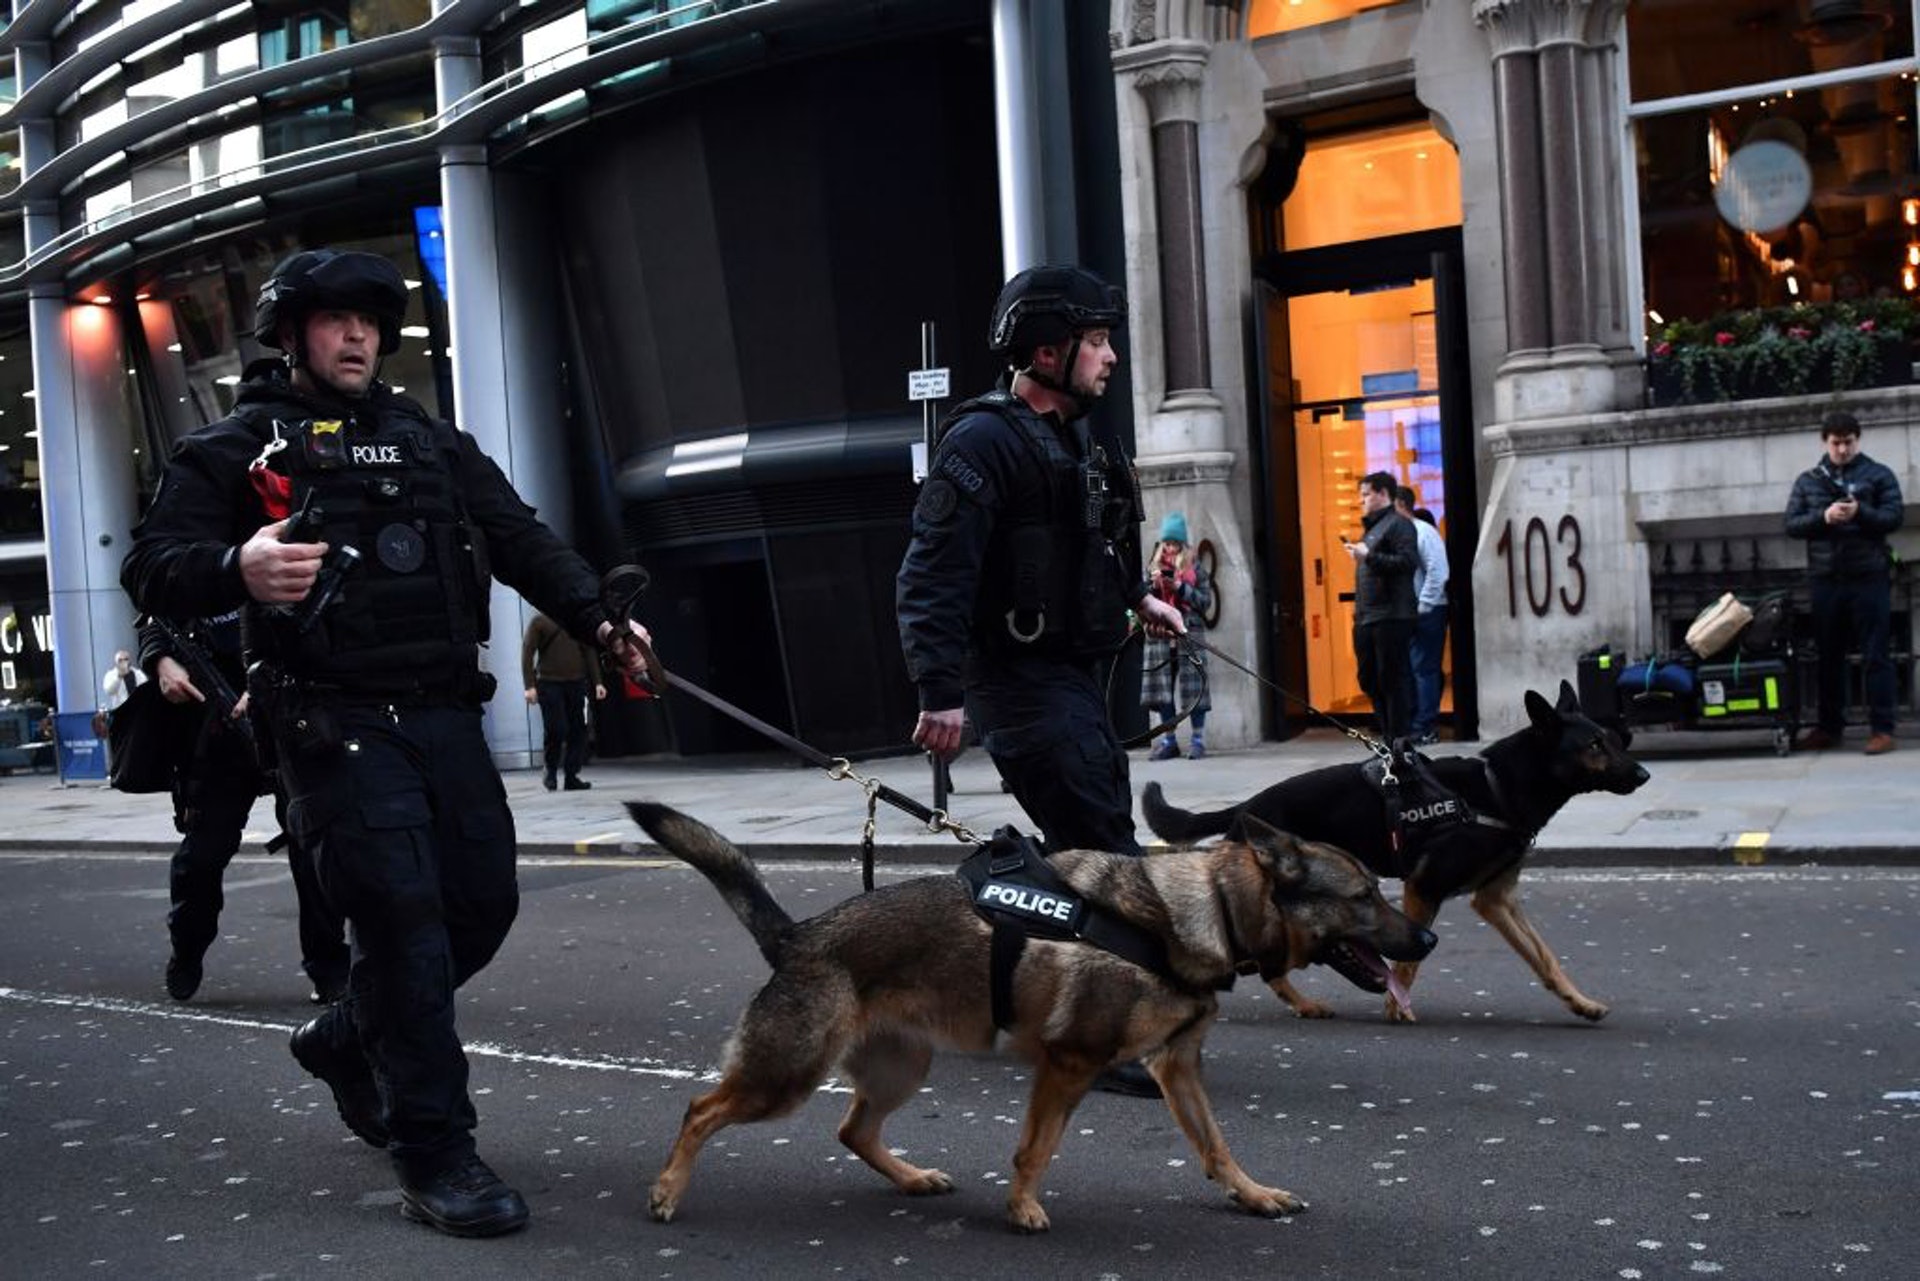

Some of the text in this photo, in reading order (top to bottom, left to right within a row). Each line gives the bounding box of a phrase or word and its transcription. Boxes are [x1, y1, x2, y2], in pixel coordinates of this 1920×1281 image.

[352, 445, 402, 464] POLICE
[1497, 514, 1586, 618] 103
[1399, 799, 1456, 823] POLICE
[983, 884, 1073, 921] POLICE
